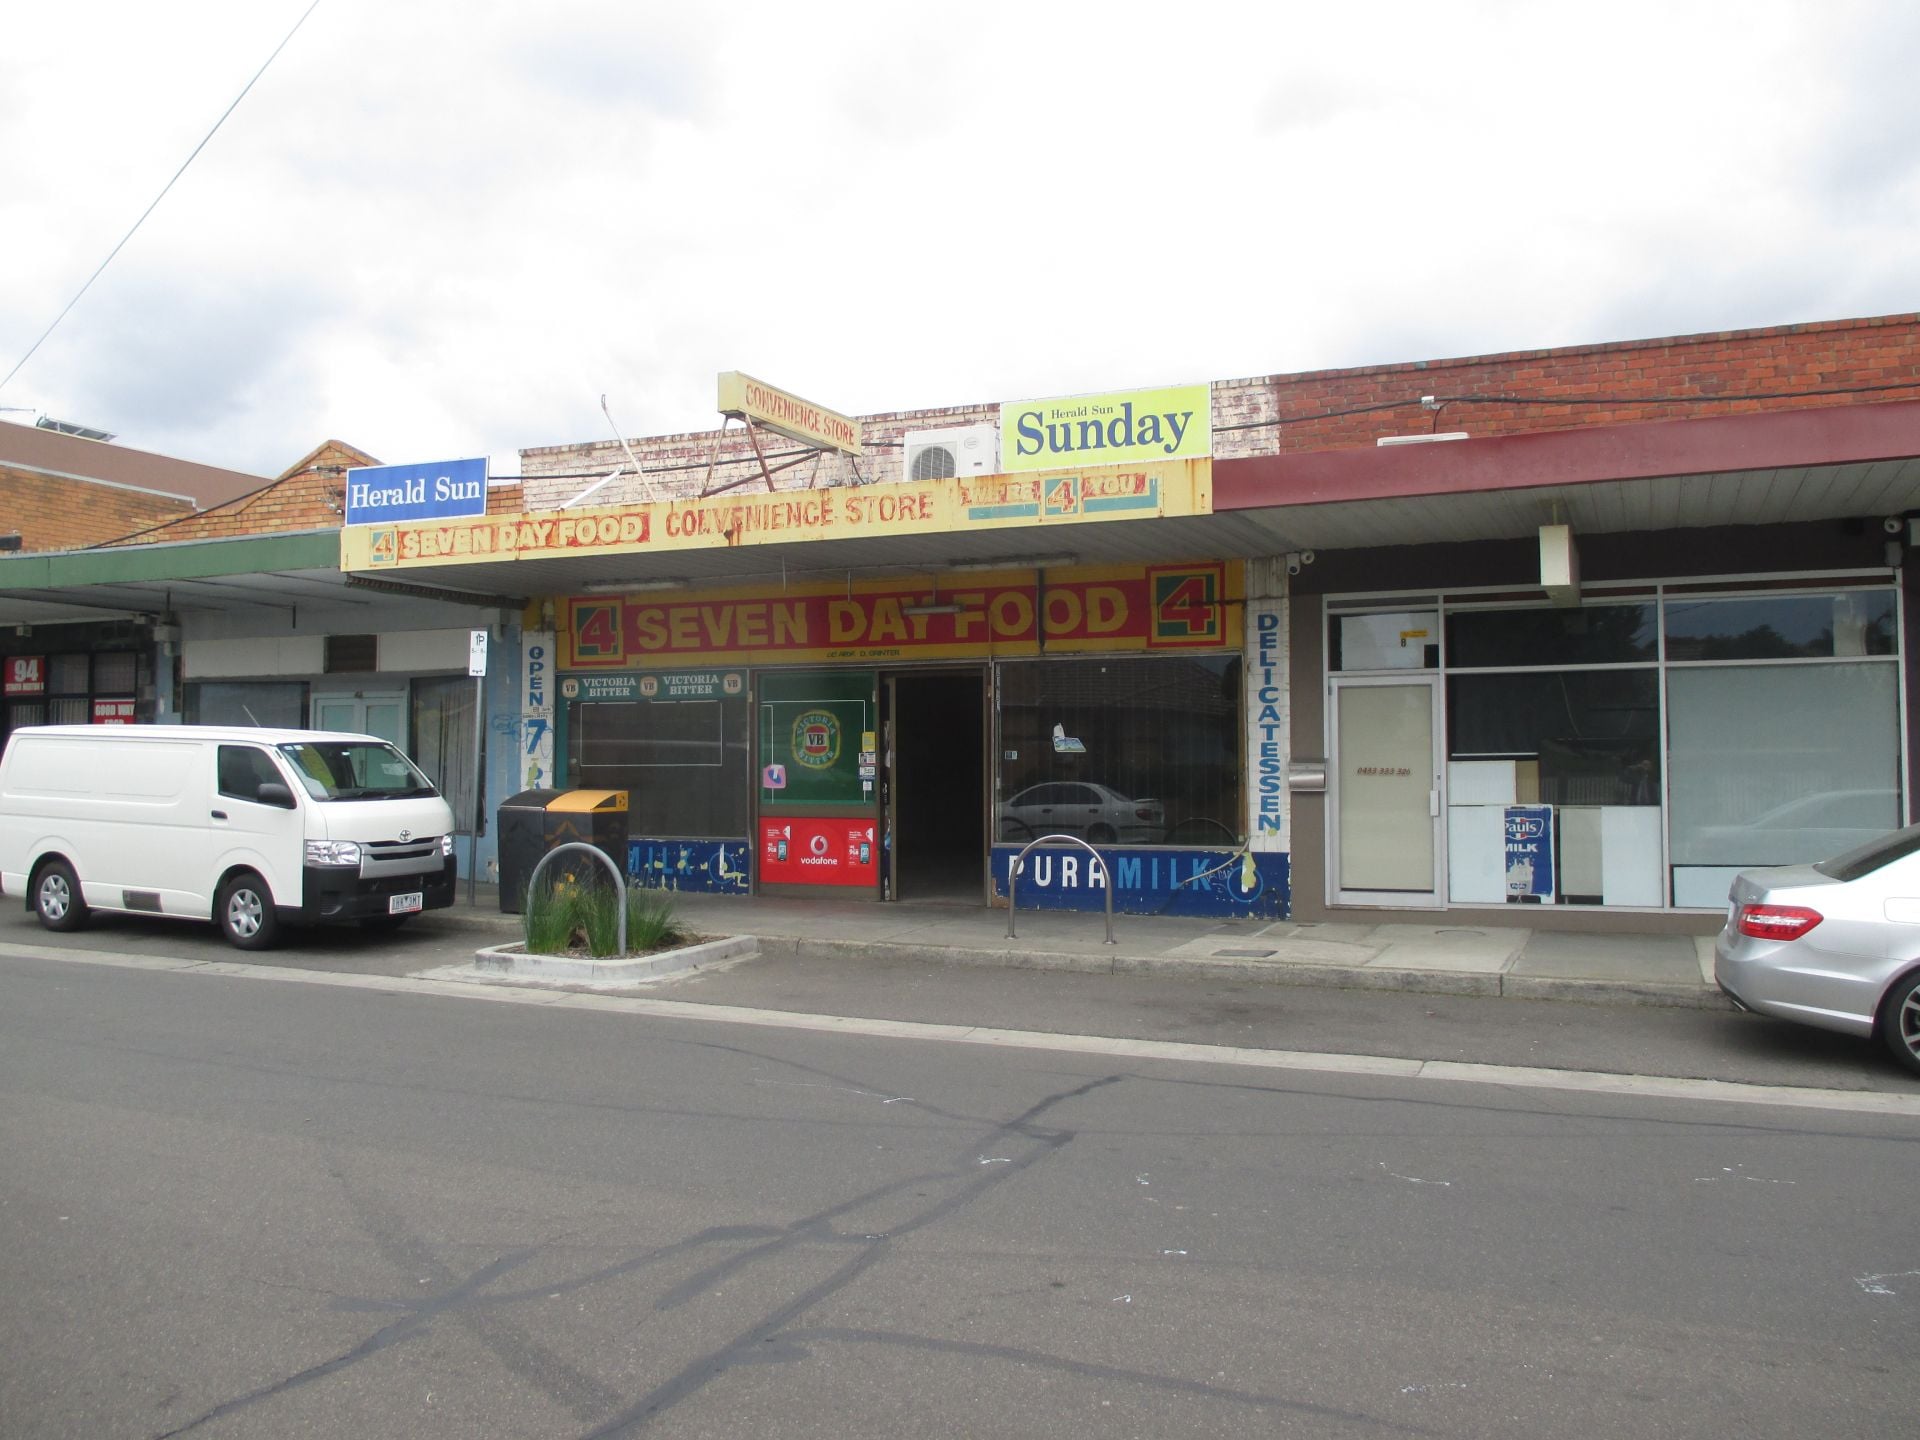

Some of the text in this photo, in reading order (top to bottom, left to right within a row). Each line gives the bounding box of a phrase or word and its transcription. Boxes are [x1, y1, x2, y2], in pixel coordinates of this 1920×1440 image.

[745, 383, 855, 446] CONVENIENCE STORE
[1051, 405, 1114, 420] Herald Sun
[1016, 402, 1194, 456] Sunday
[350, 477, 482, 509] Herald Sun
[402, 527, 491, 558] SEVEN
[503, 522, 553, 551] DAY
[559, 515, 643, 546] FOOD
[846, 491, 934, 525] STORE
[1046, 479, 1076, 513] 4
[1086, 473, 1139, 497] YOU
[579, 576, 1214, 655] 4 SEVEN DAY FOOD 4
[14, 659, 39, 683] 94
[528, 646, 545, 707] OPEN
[583, 677, 637, 687] VICTORIA
[662, 675, 720, 685] VICTORIA
[588, 687, 631, 697] BITTER
[669, 685, 713, 695] BITTER
[726, 679, 738, 688] VB
[796, 716, 836, 735] VICTORIA
[1257, 614, 1281, 831] DELICATESSEN
[527, 719, 548, 755] 7
[808, 733, 825, 746] VB
[800, 856, 838, 865] vodafone
[1008, 855, 1106, 888] PURA
[1117, 857, 1212, 891] MILK
